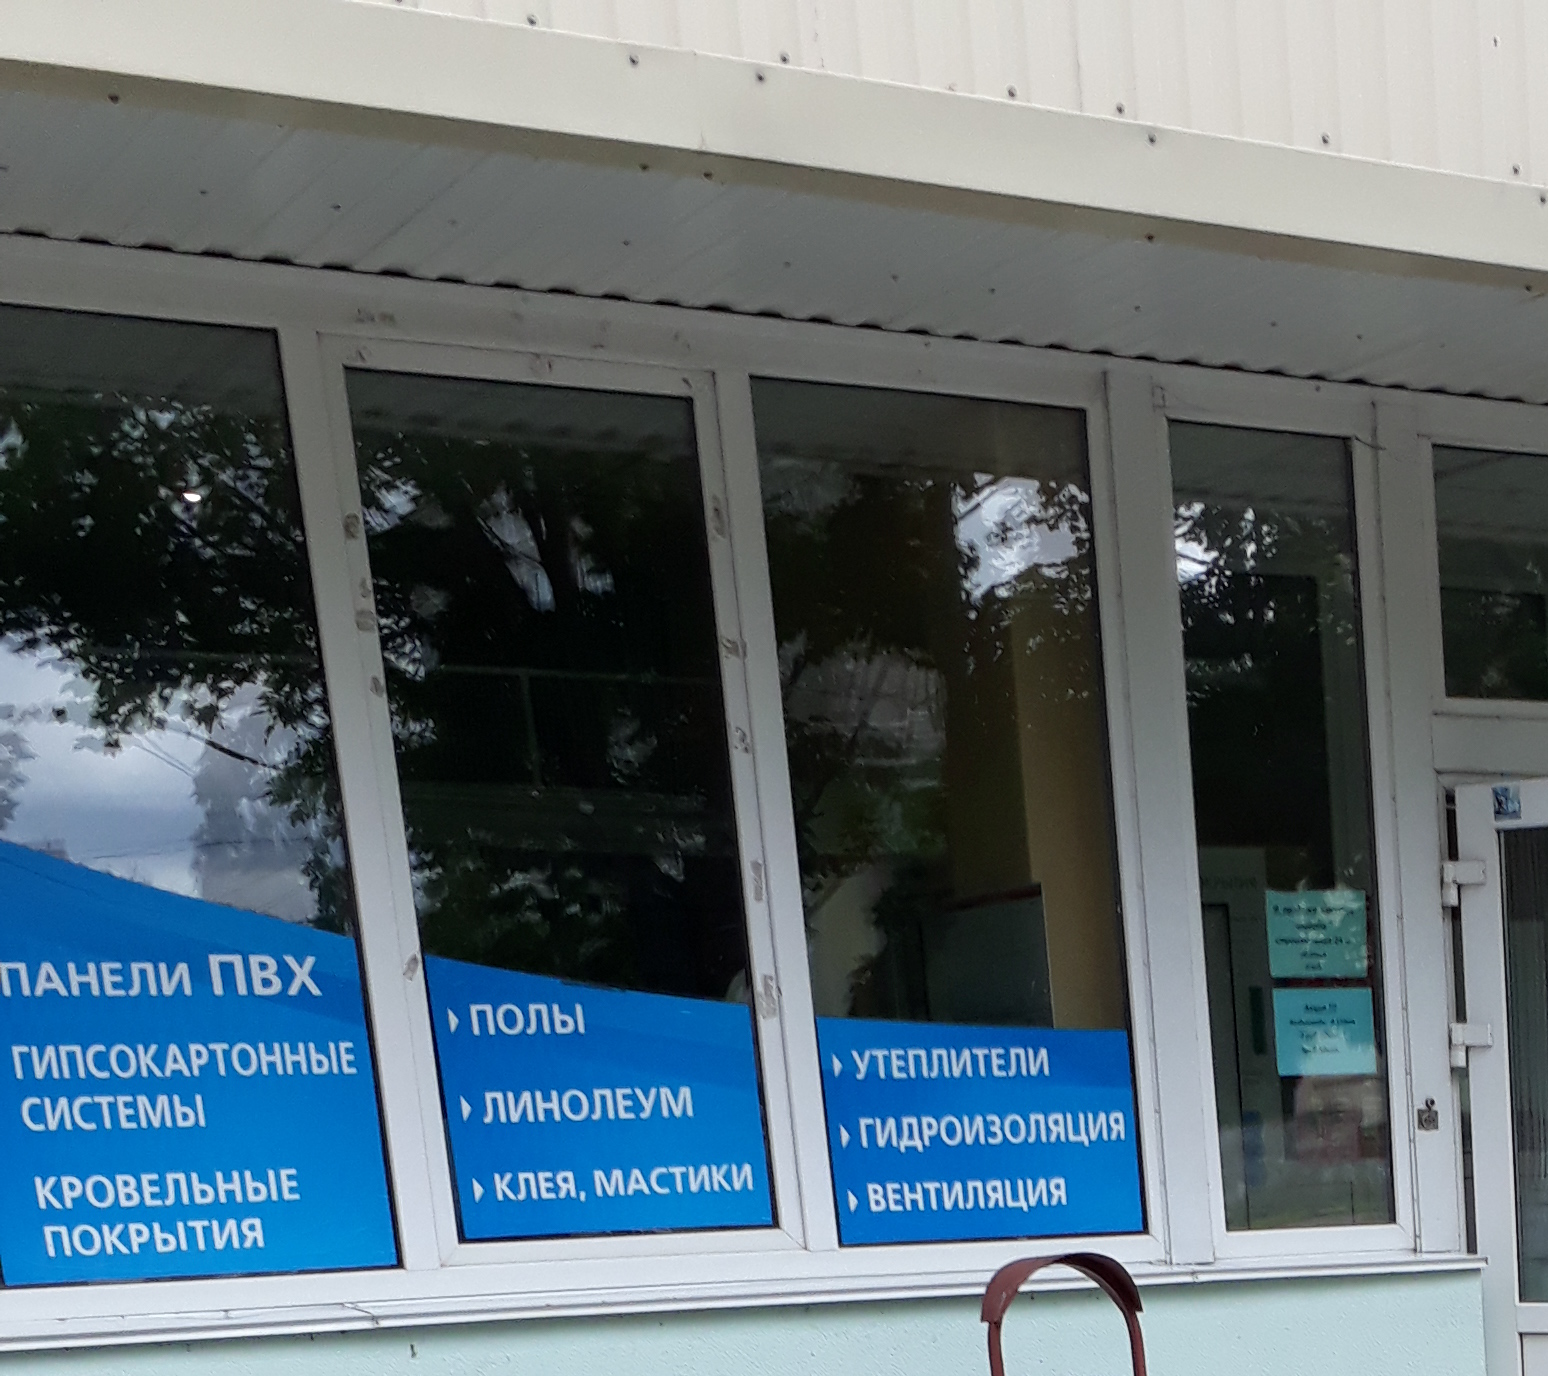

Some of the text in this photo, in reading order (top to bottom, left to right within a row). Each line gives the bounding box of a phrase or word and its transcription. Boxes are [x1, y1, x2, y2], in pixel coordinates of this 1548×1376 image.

[0, 953, 323, 998] ПАНЕЛИ ПВХ
[469, 1003, 586, 1036] ПОЛЫ
[11, 1041, 359, 1080] ГИПСОКАРТОННЫЕ
[851, 1047, 1051, 1081] УТЕПЛИТЕЛИ
[20, 1094, 207, 1132] СИСТЕМЫ
[483, 1086, 694, 1125] ЛИНОЛЕУМ
[858, 1110, 1127, 1154] ГИДРОИЗОЛЯЦИЯ
[33, 1167, 301, 1211] КРОВЕЛЬНЫЕ
[493, 1163, 754, 1203] КЛЕЯ, МАСТИКИ
[866, 1176, 1068, 1214] ВЕНТИЛЯЦИЯ
[42, 1217, 266, 1259] ПОКРЫТИЯ
